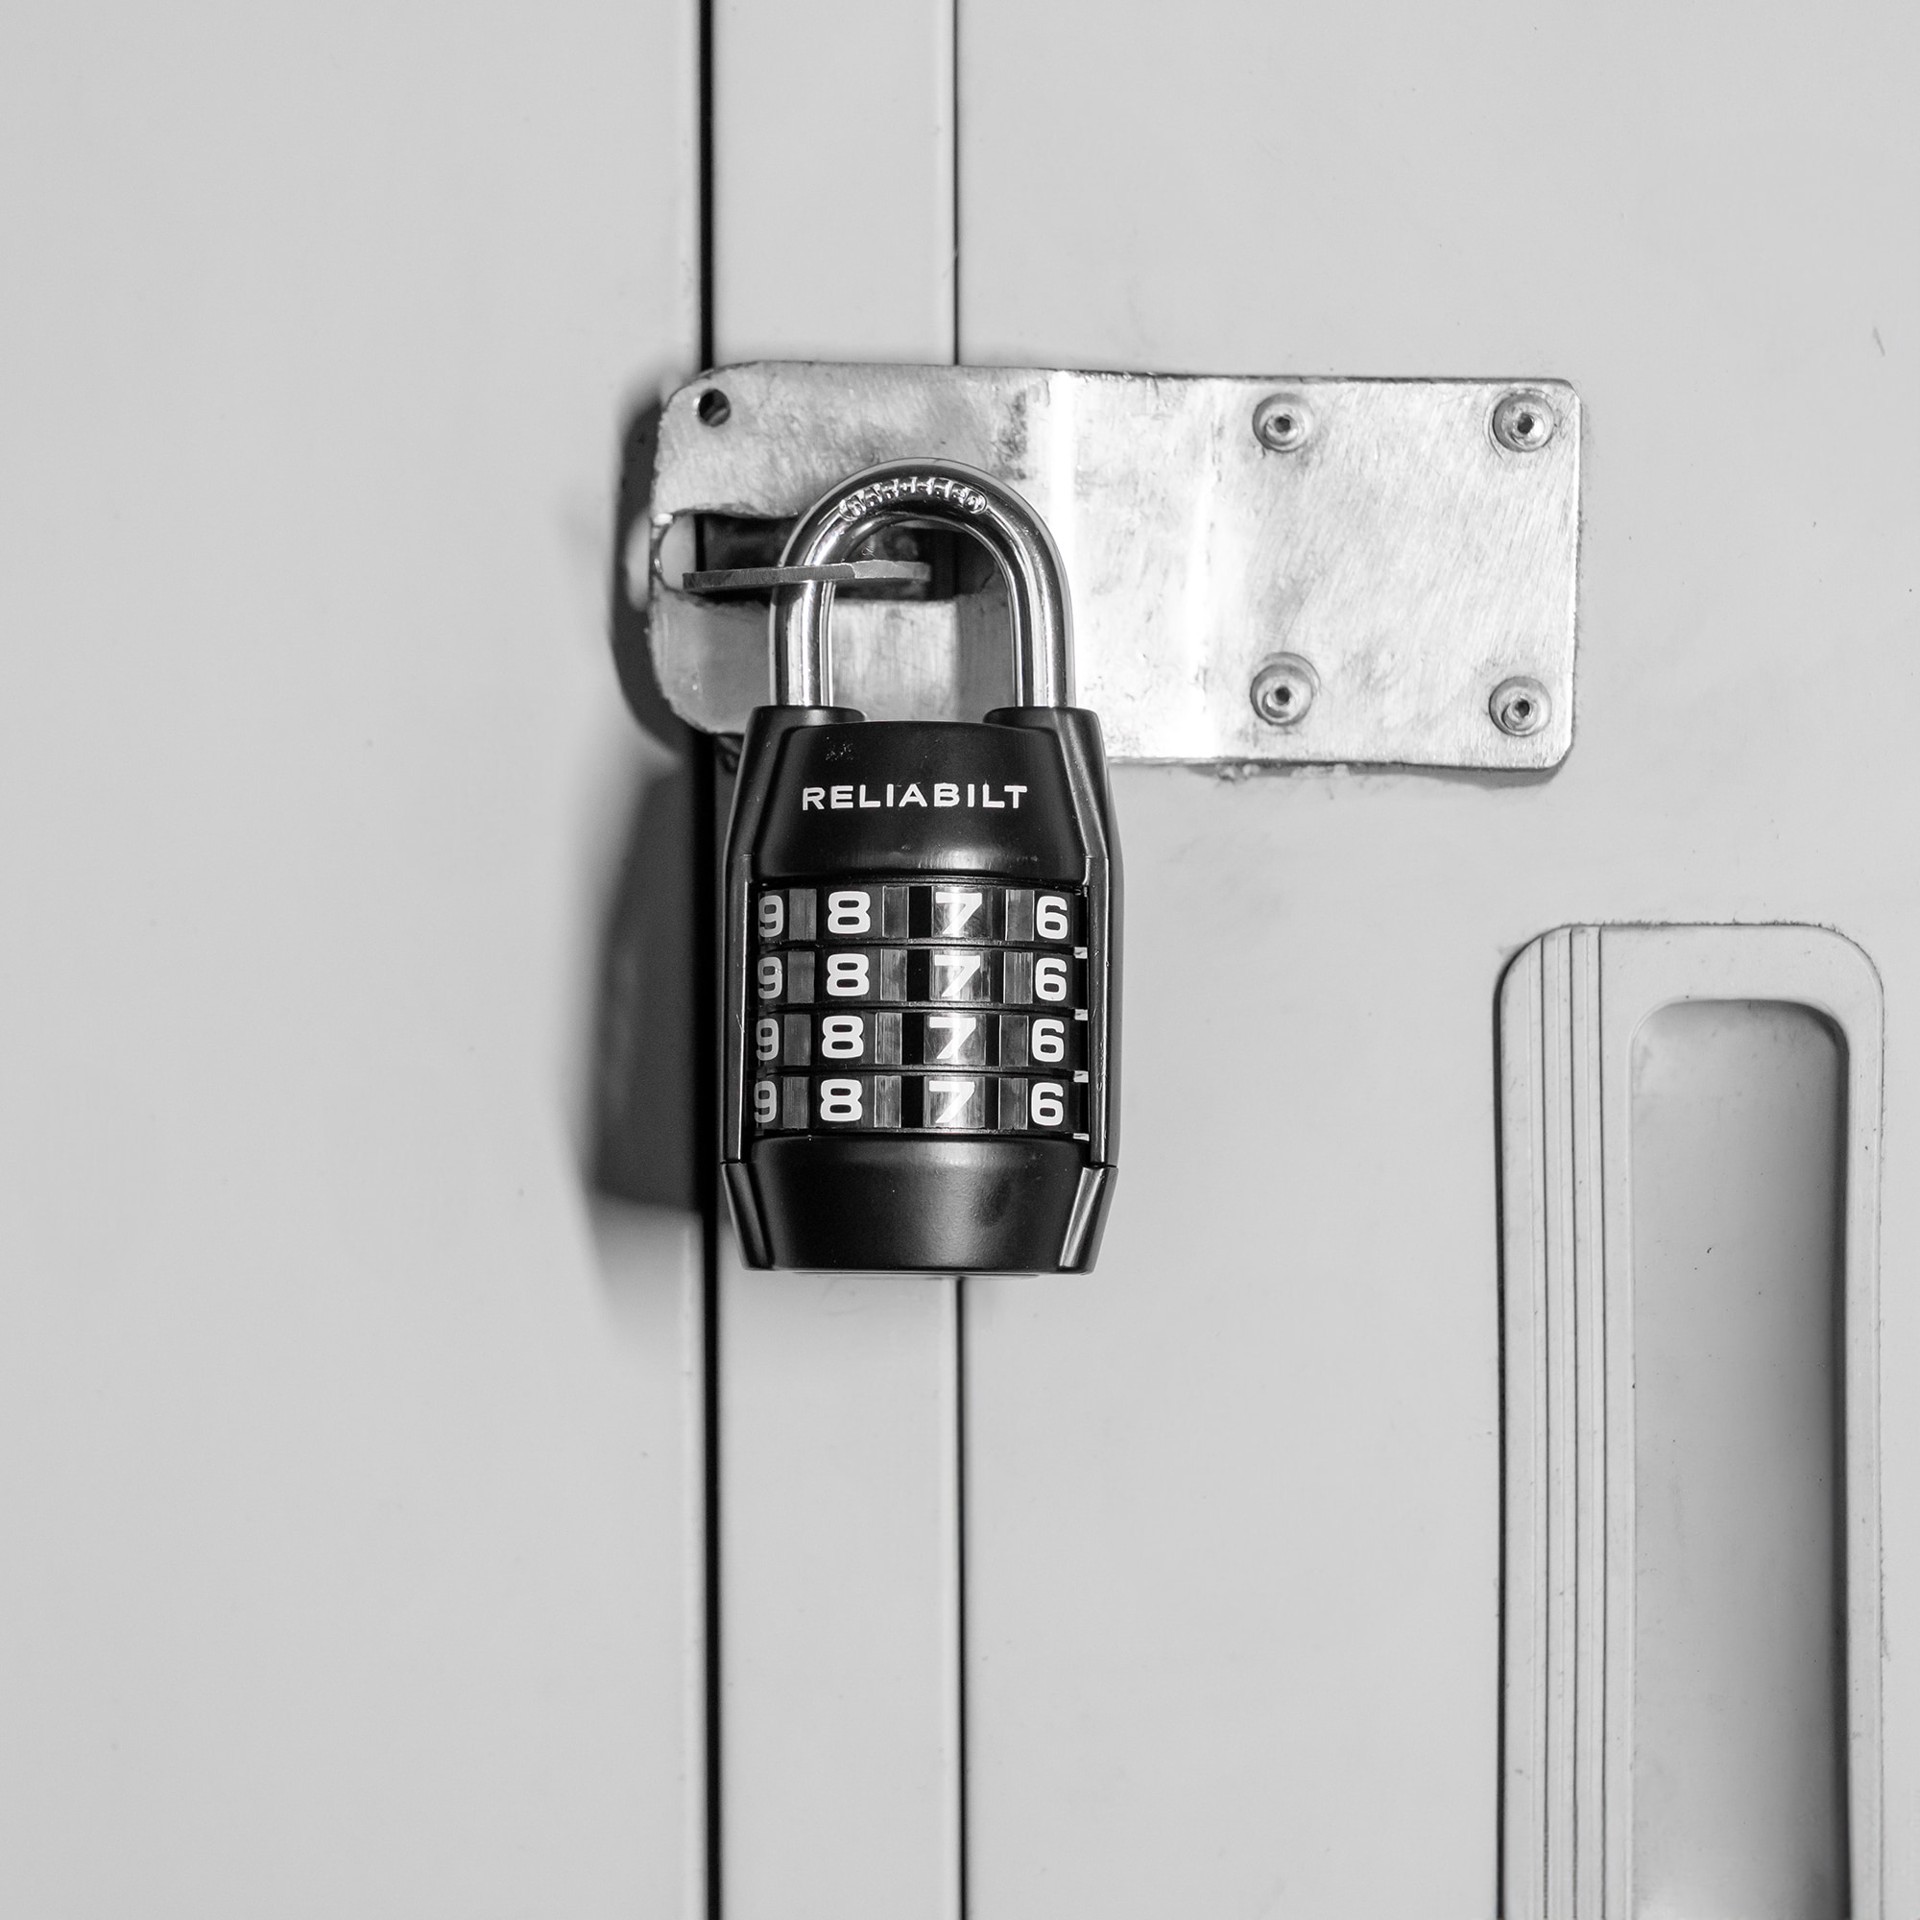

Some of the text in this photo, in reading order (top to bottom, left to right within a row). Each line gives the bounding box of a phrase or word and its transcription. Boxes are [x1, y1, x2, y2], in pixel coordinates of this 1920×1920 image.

[802, 782, 1028, 812] RELIABILT
[758, 890, 1069, 940] 9 8 7 6
[757, 952, 1068, 1002] 9 8 7 6
[755, 1014, 1065, 1063] 9 8 7 6
[753, 1078, 1064, 1127] 9 8 7 6
